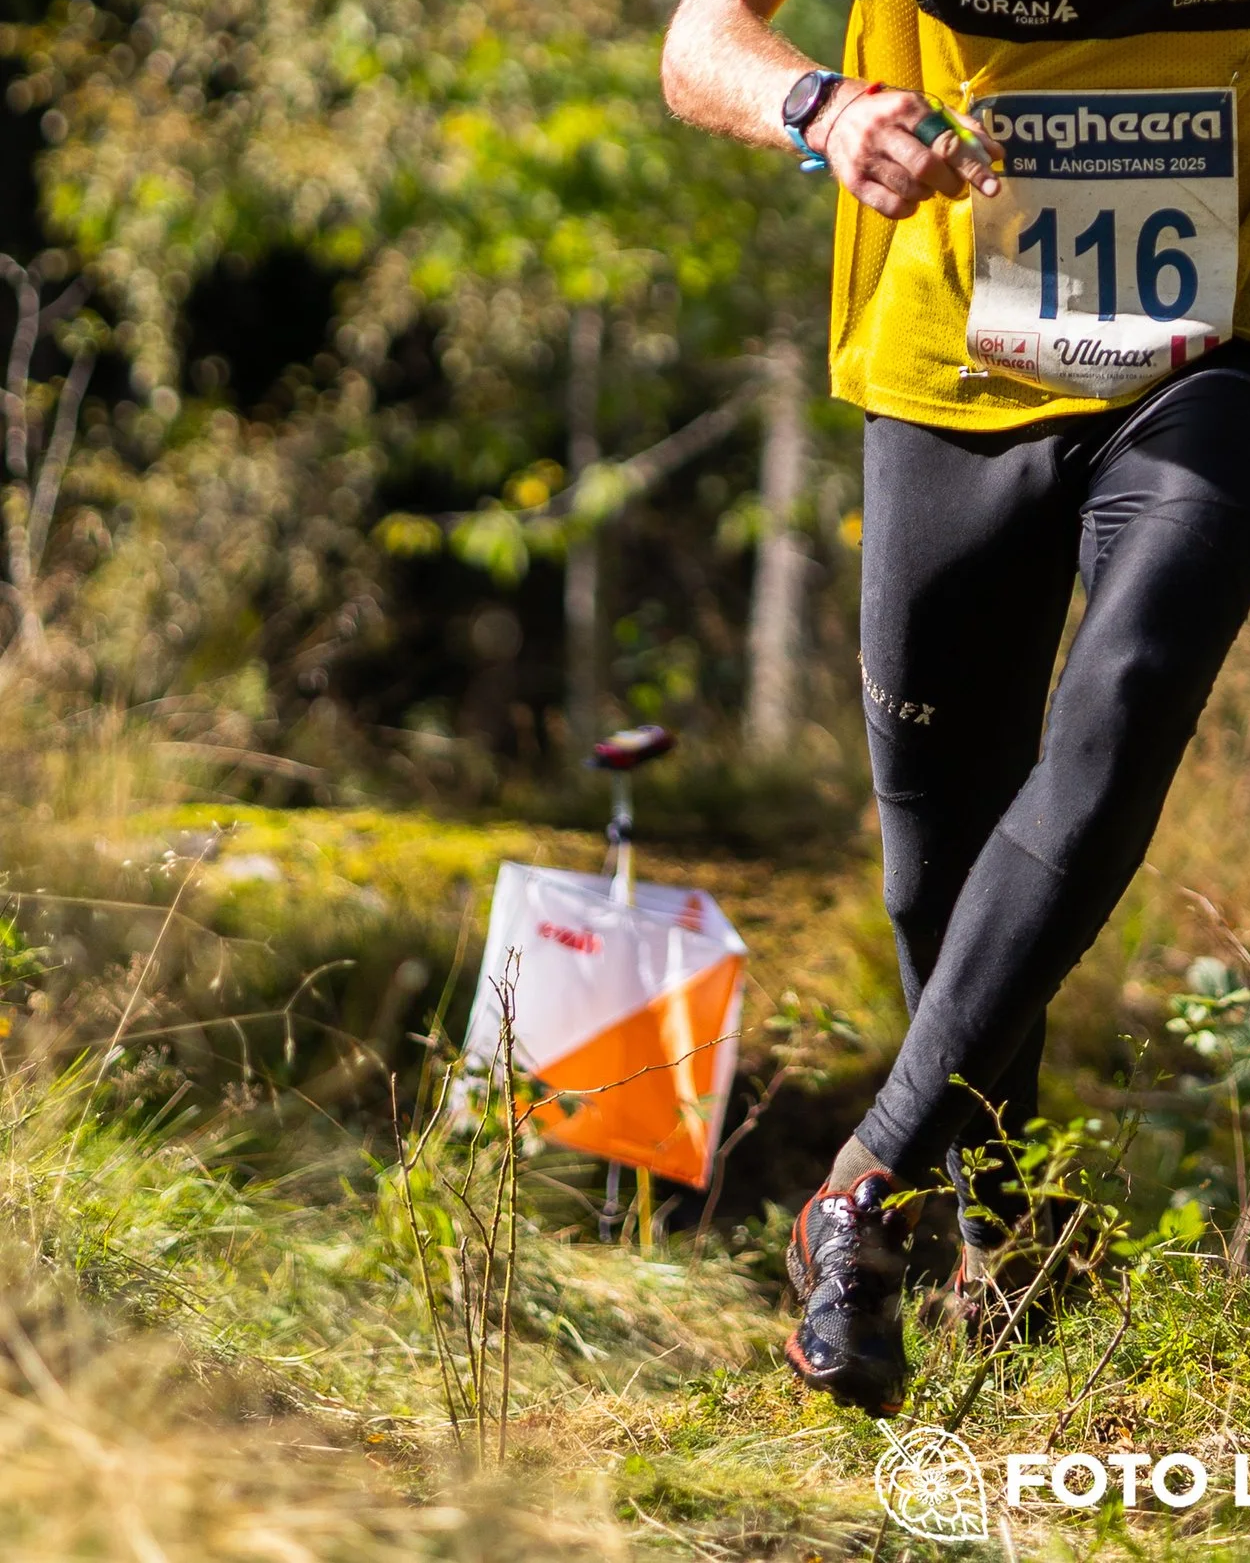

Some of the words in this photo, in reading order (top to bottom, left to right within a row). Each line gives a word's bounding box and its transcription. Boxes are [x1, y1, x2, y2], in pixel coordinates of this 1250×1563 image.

[1015, 15, 1050, 25] FOREST
[982, 106, 1222, 149] bagheera
[1013, 158, 1037, 171] SM
[1050, 157, 1165, 173] LÅNGDISTANS
[1170, 157, 1206, 171] 2025
[1018, 207, 1199, 322] 116
[1053, 337, 1156, 368] Ullmax
